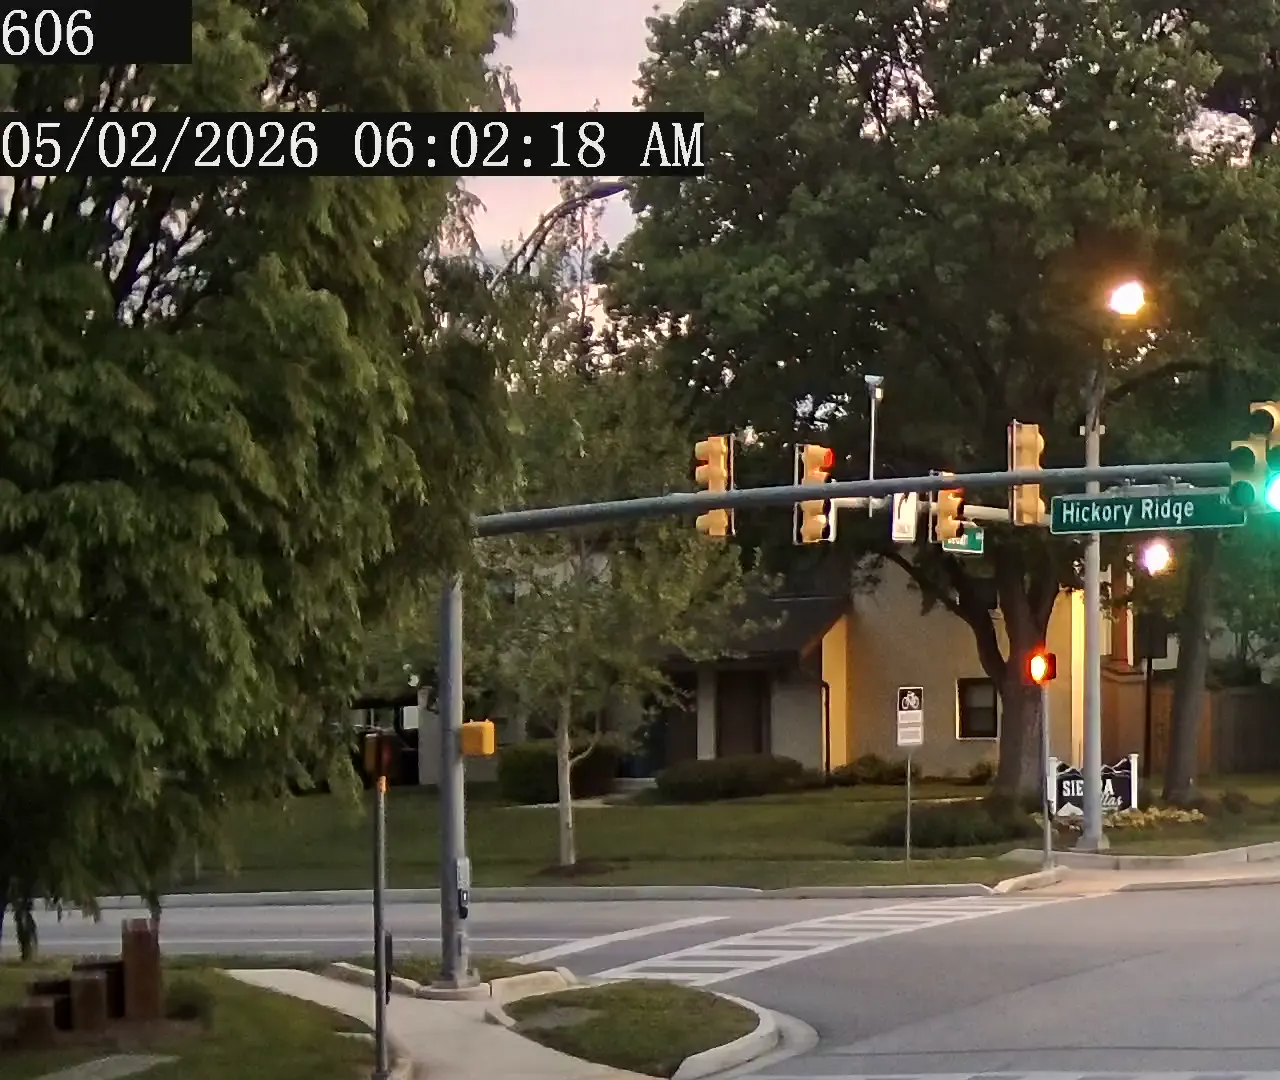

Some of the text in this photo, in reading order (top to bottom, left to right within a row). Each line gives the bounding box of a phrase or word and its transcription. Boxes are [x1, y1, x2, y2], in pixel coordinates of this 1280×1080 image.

[1062, 502, 1134, 526] Hickory
[1141, 499, 1194, 525] Ridge
[1062, 779, 1115, 797] SIEA
